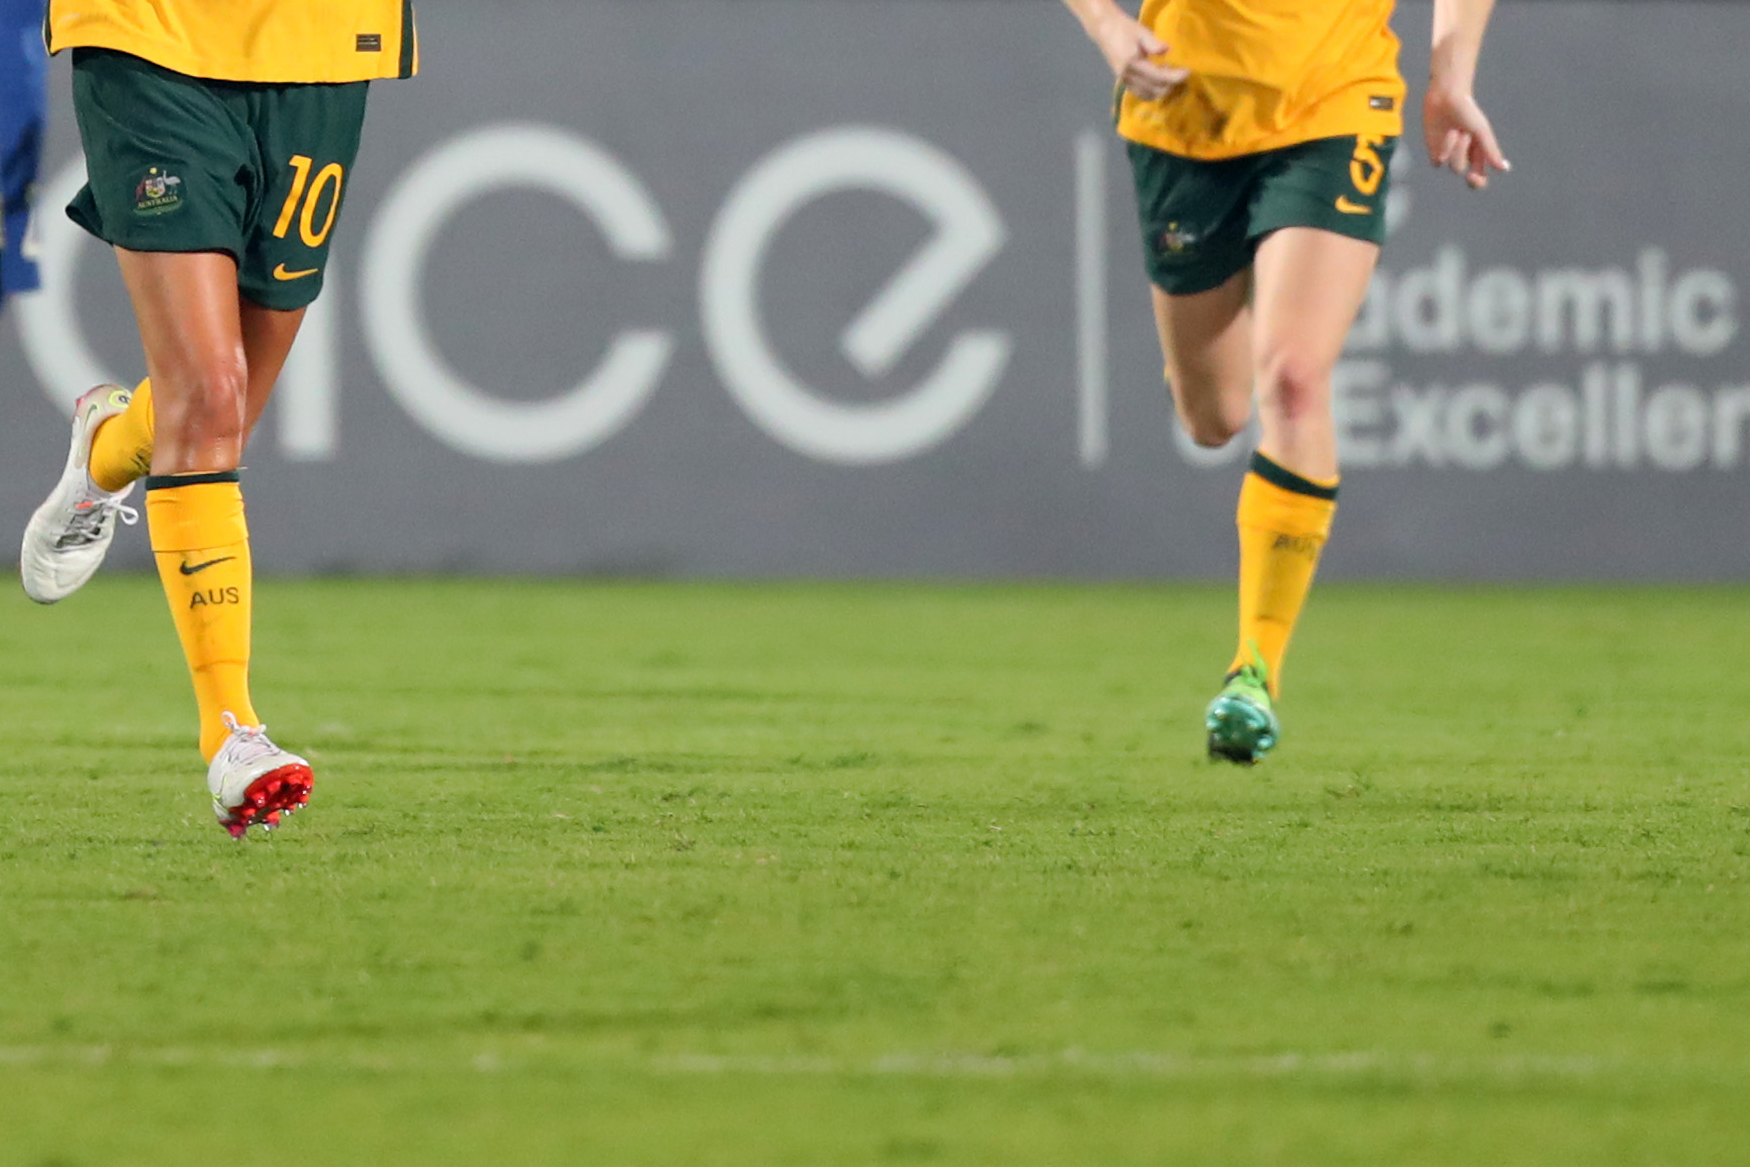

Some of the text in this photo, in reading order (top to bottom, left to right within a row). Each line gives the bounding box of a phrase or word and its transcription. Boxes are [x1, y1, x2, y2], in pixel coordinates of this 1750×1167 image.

[1349, 133, 1385, 195] 5
[137, 195, 179, 209] AUSTRALIA
[273, 154, 344, 248] 10
[189, 586, 240, 610] AUS
